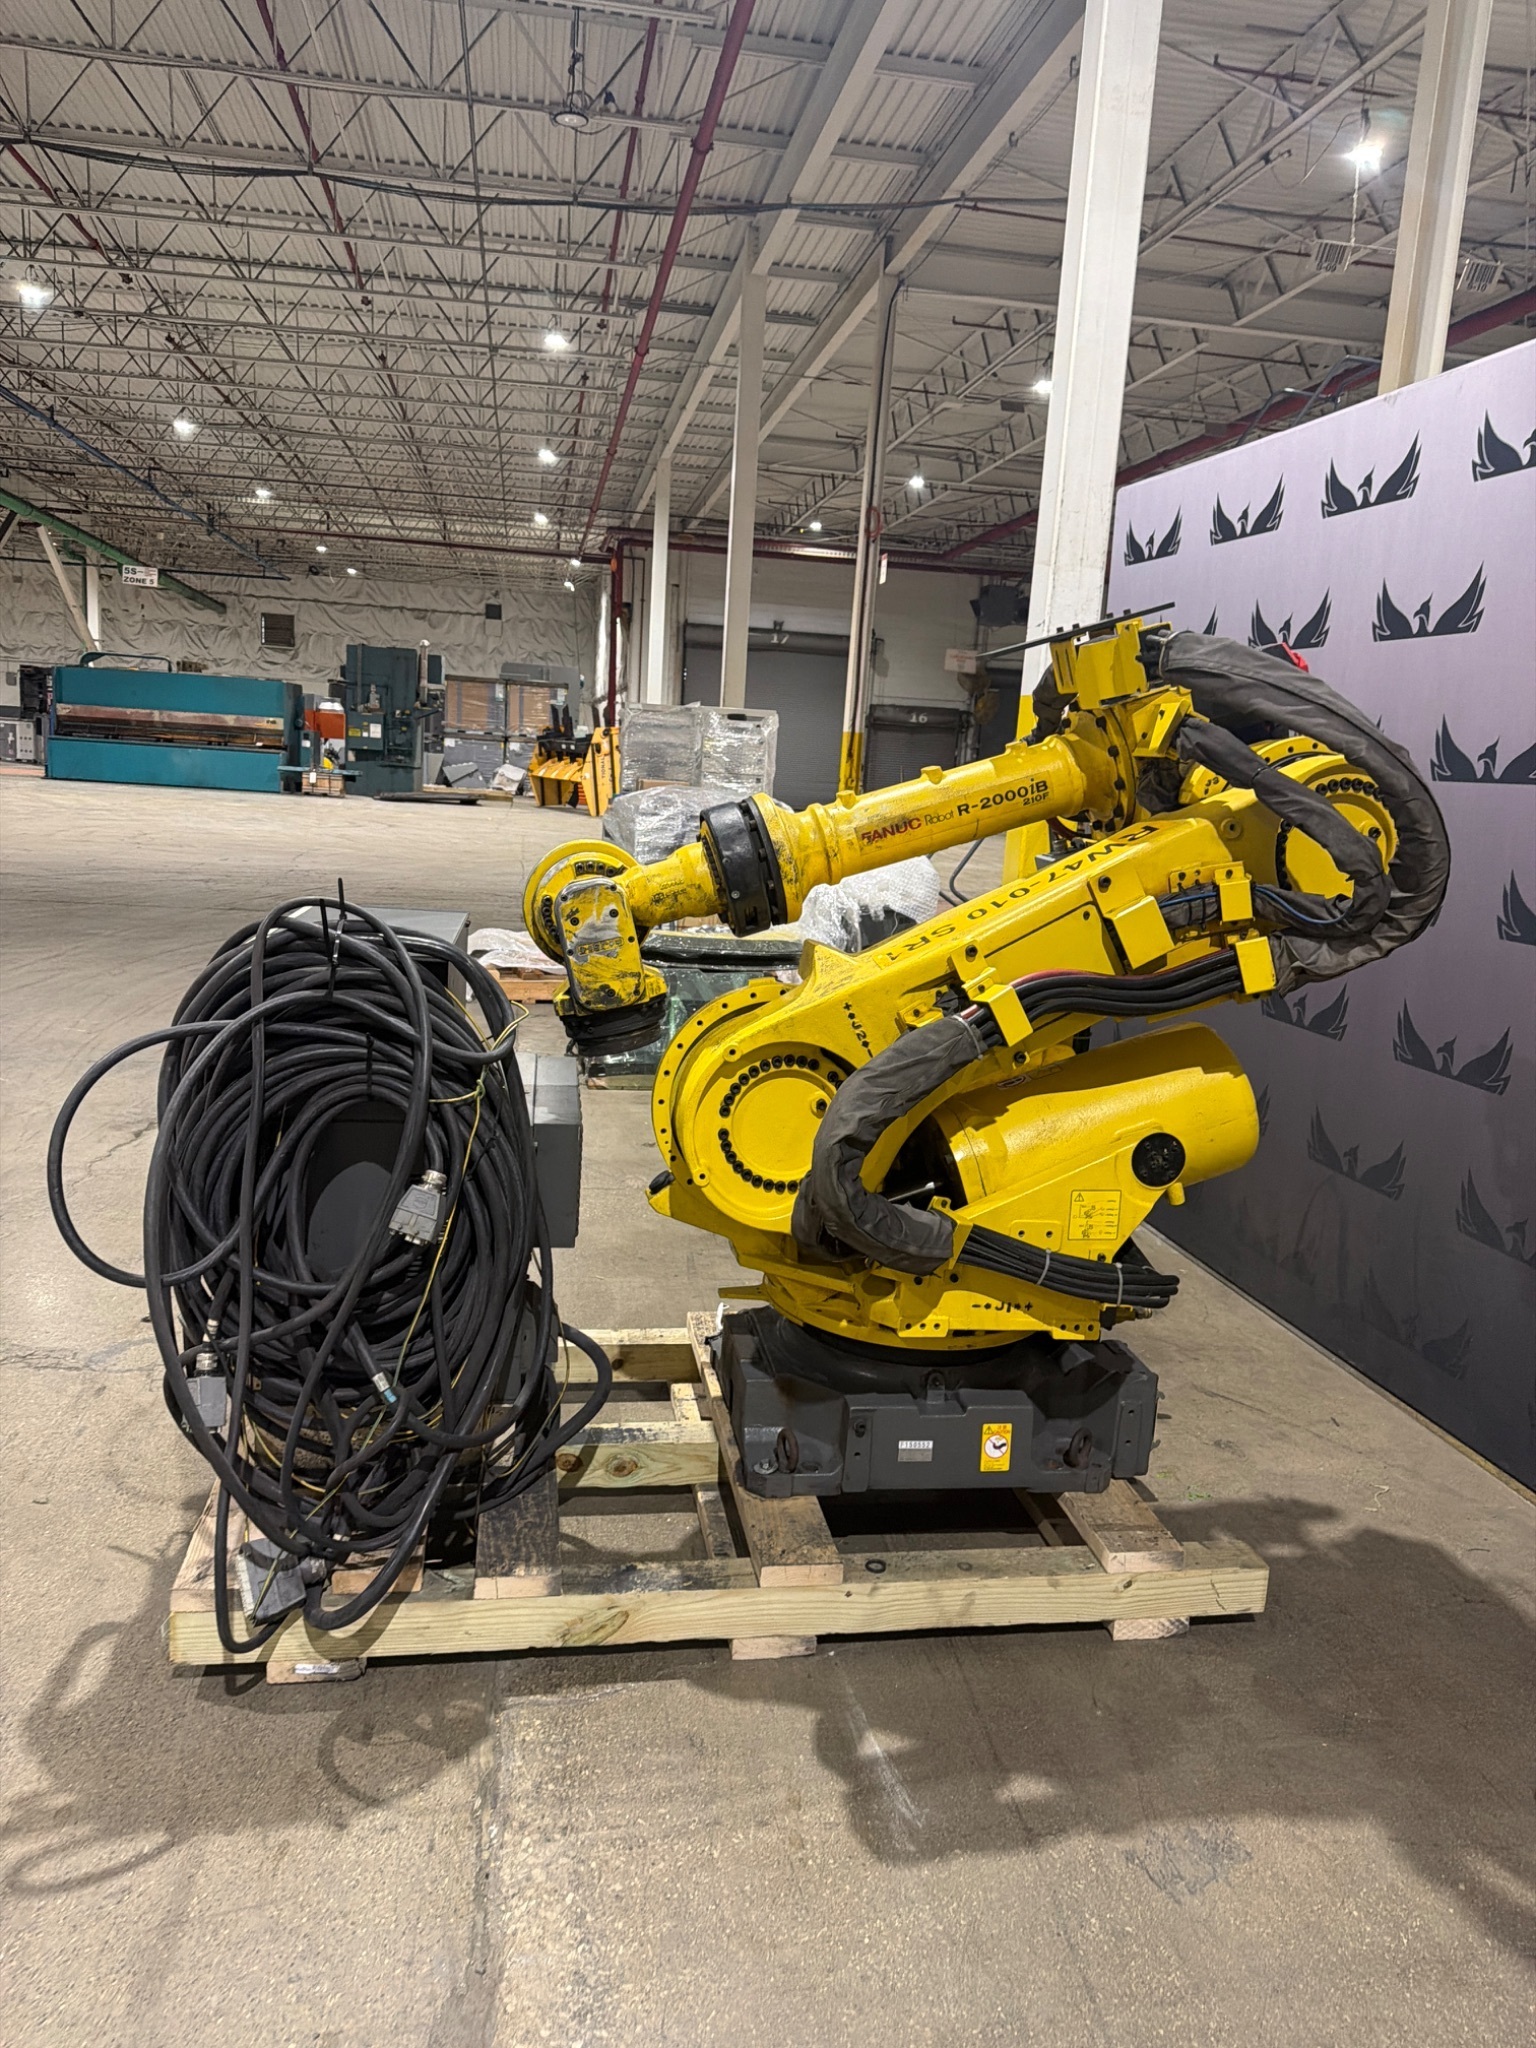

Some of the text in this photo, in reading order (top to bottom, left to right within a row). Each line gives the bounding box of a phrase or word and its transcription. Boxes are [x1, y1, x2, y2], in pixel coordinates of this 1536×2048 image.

[123, 576, 147, 585] ZONE
[770, 633, 790, 644] 17
[909, 712, 928, 723] 16
[1023, 791, 1050, 806] 210F
[861, 778, 1049, 843] FANUC Robot R-2000iB
[967, 824, 1160, 920] RW47-010
